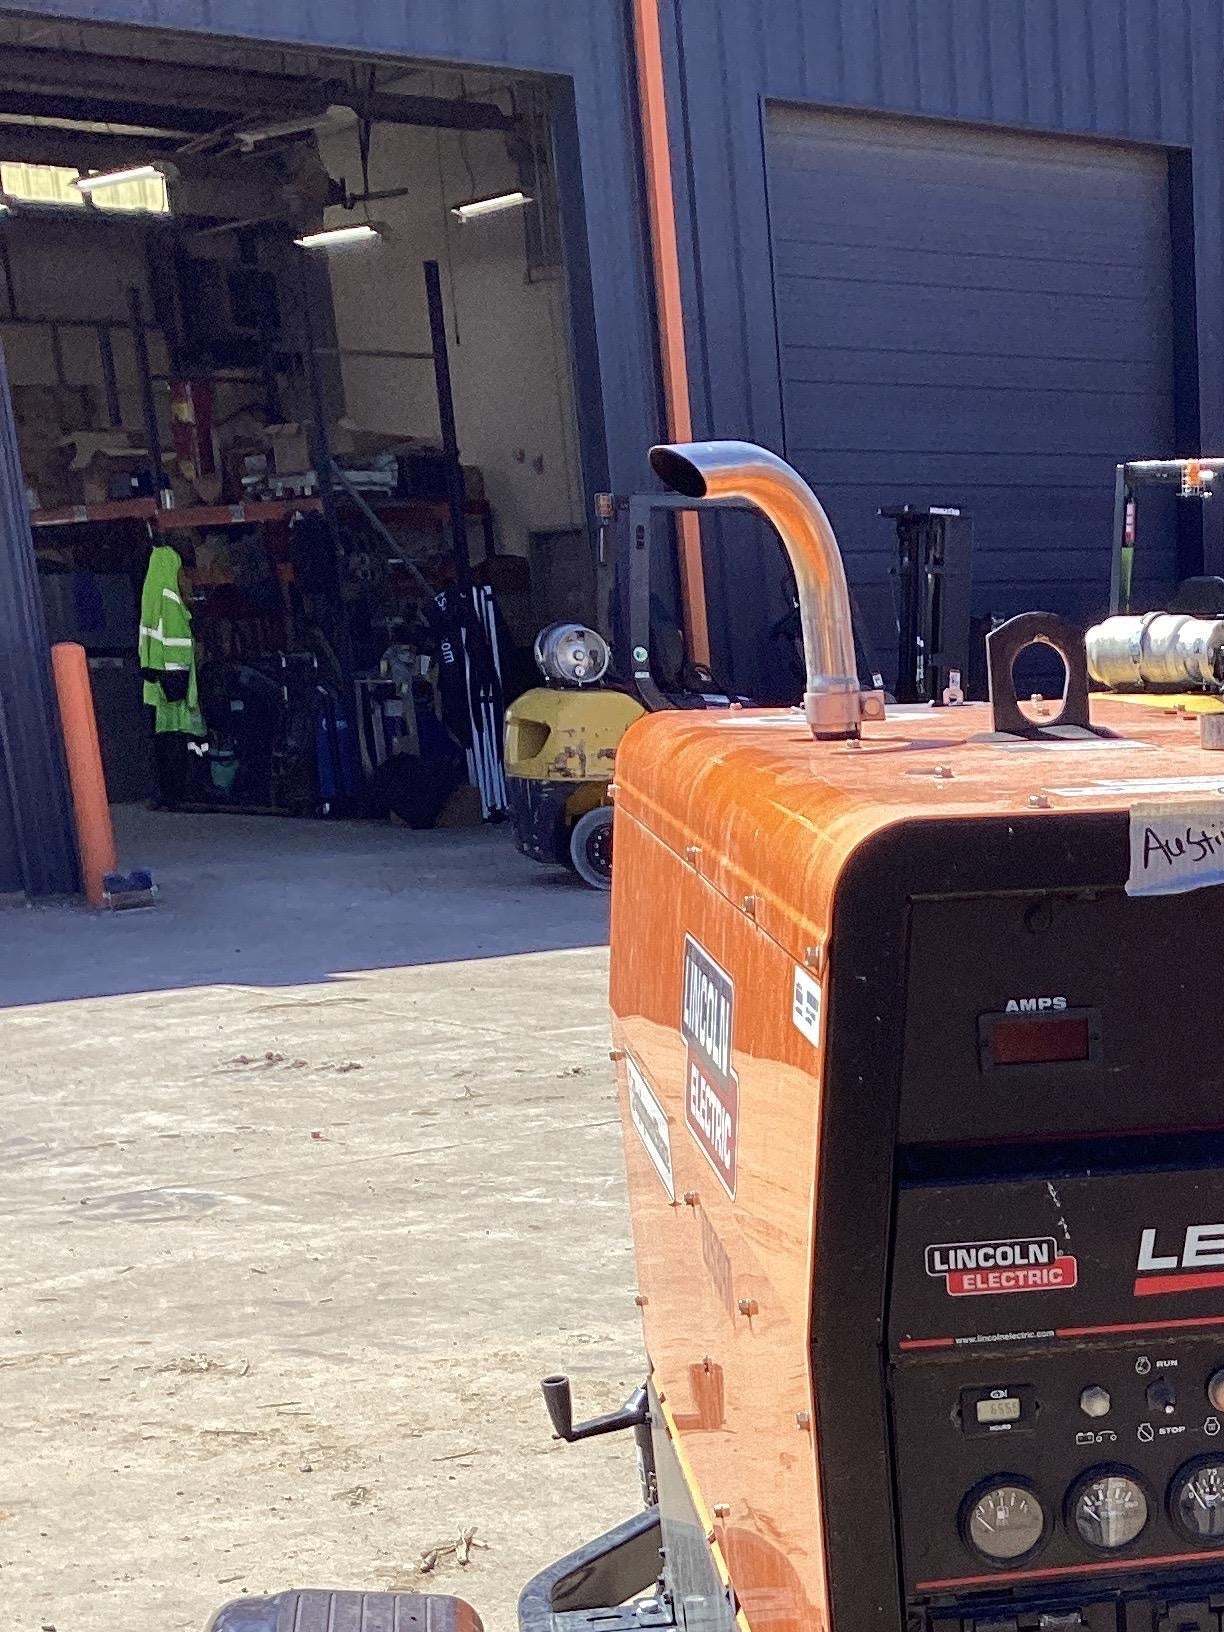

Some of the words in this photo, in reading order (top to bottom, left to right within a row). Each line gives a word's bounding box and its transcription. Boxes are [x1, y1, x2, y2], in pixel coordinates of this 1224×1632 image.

[1005, 996, 1068, 1014] AMPS
[683, 956, 731, 1078] LINCOLN
[690, 1061, 732, 1171] ELECTRIC
[934, 1242, 1050, 1272] LINCOLN
[962, 1266, 1063, 1290] ELECTRIC
[955, 1330, 1055, 1345] www.lincolnelectric.com
[1156, 1359, 1178, 1368] RUN
[1159, 1425, 1186, 1436] STOP
